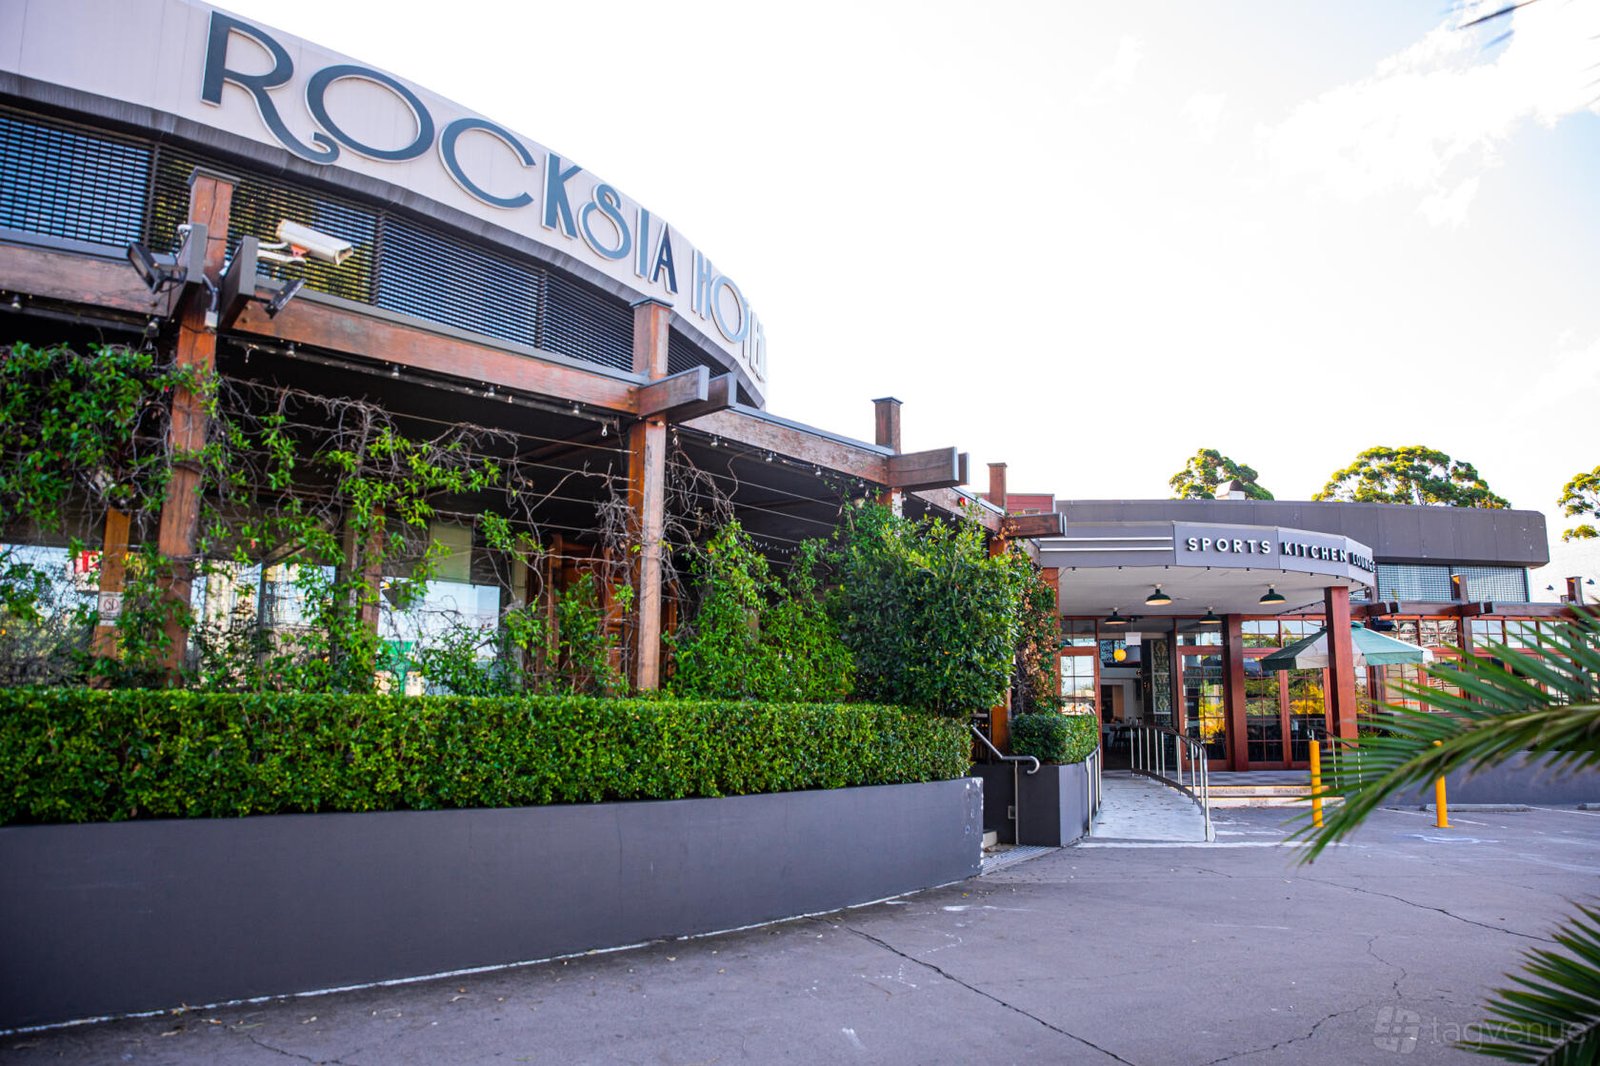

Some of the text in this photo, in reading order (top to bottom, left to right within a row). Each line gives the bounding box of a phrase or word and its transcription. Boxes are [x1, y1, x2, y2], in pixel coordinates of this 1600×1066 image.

[201, 10, 678, 295] ROCKSIA
[1186, 536, 1272, 555] SPORTS
[1282, 541, 1347, 563] KITCHEN
